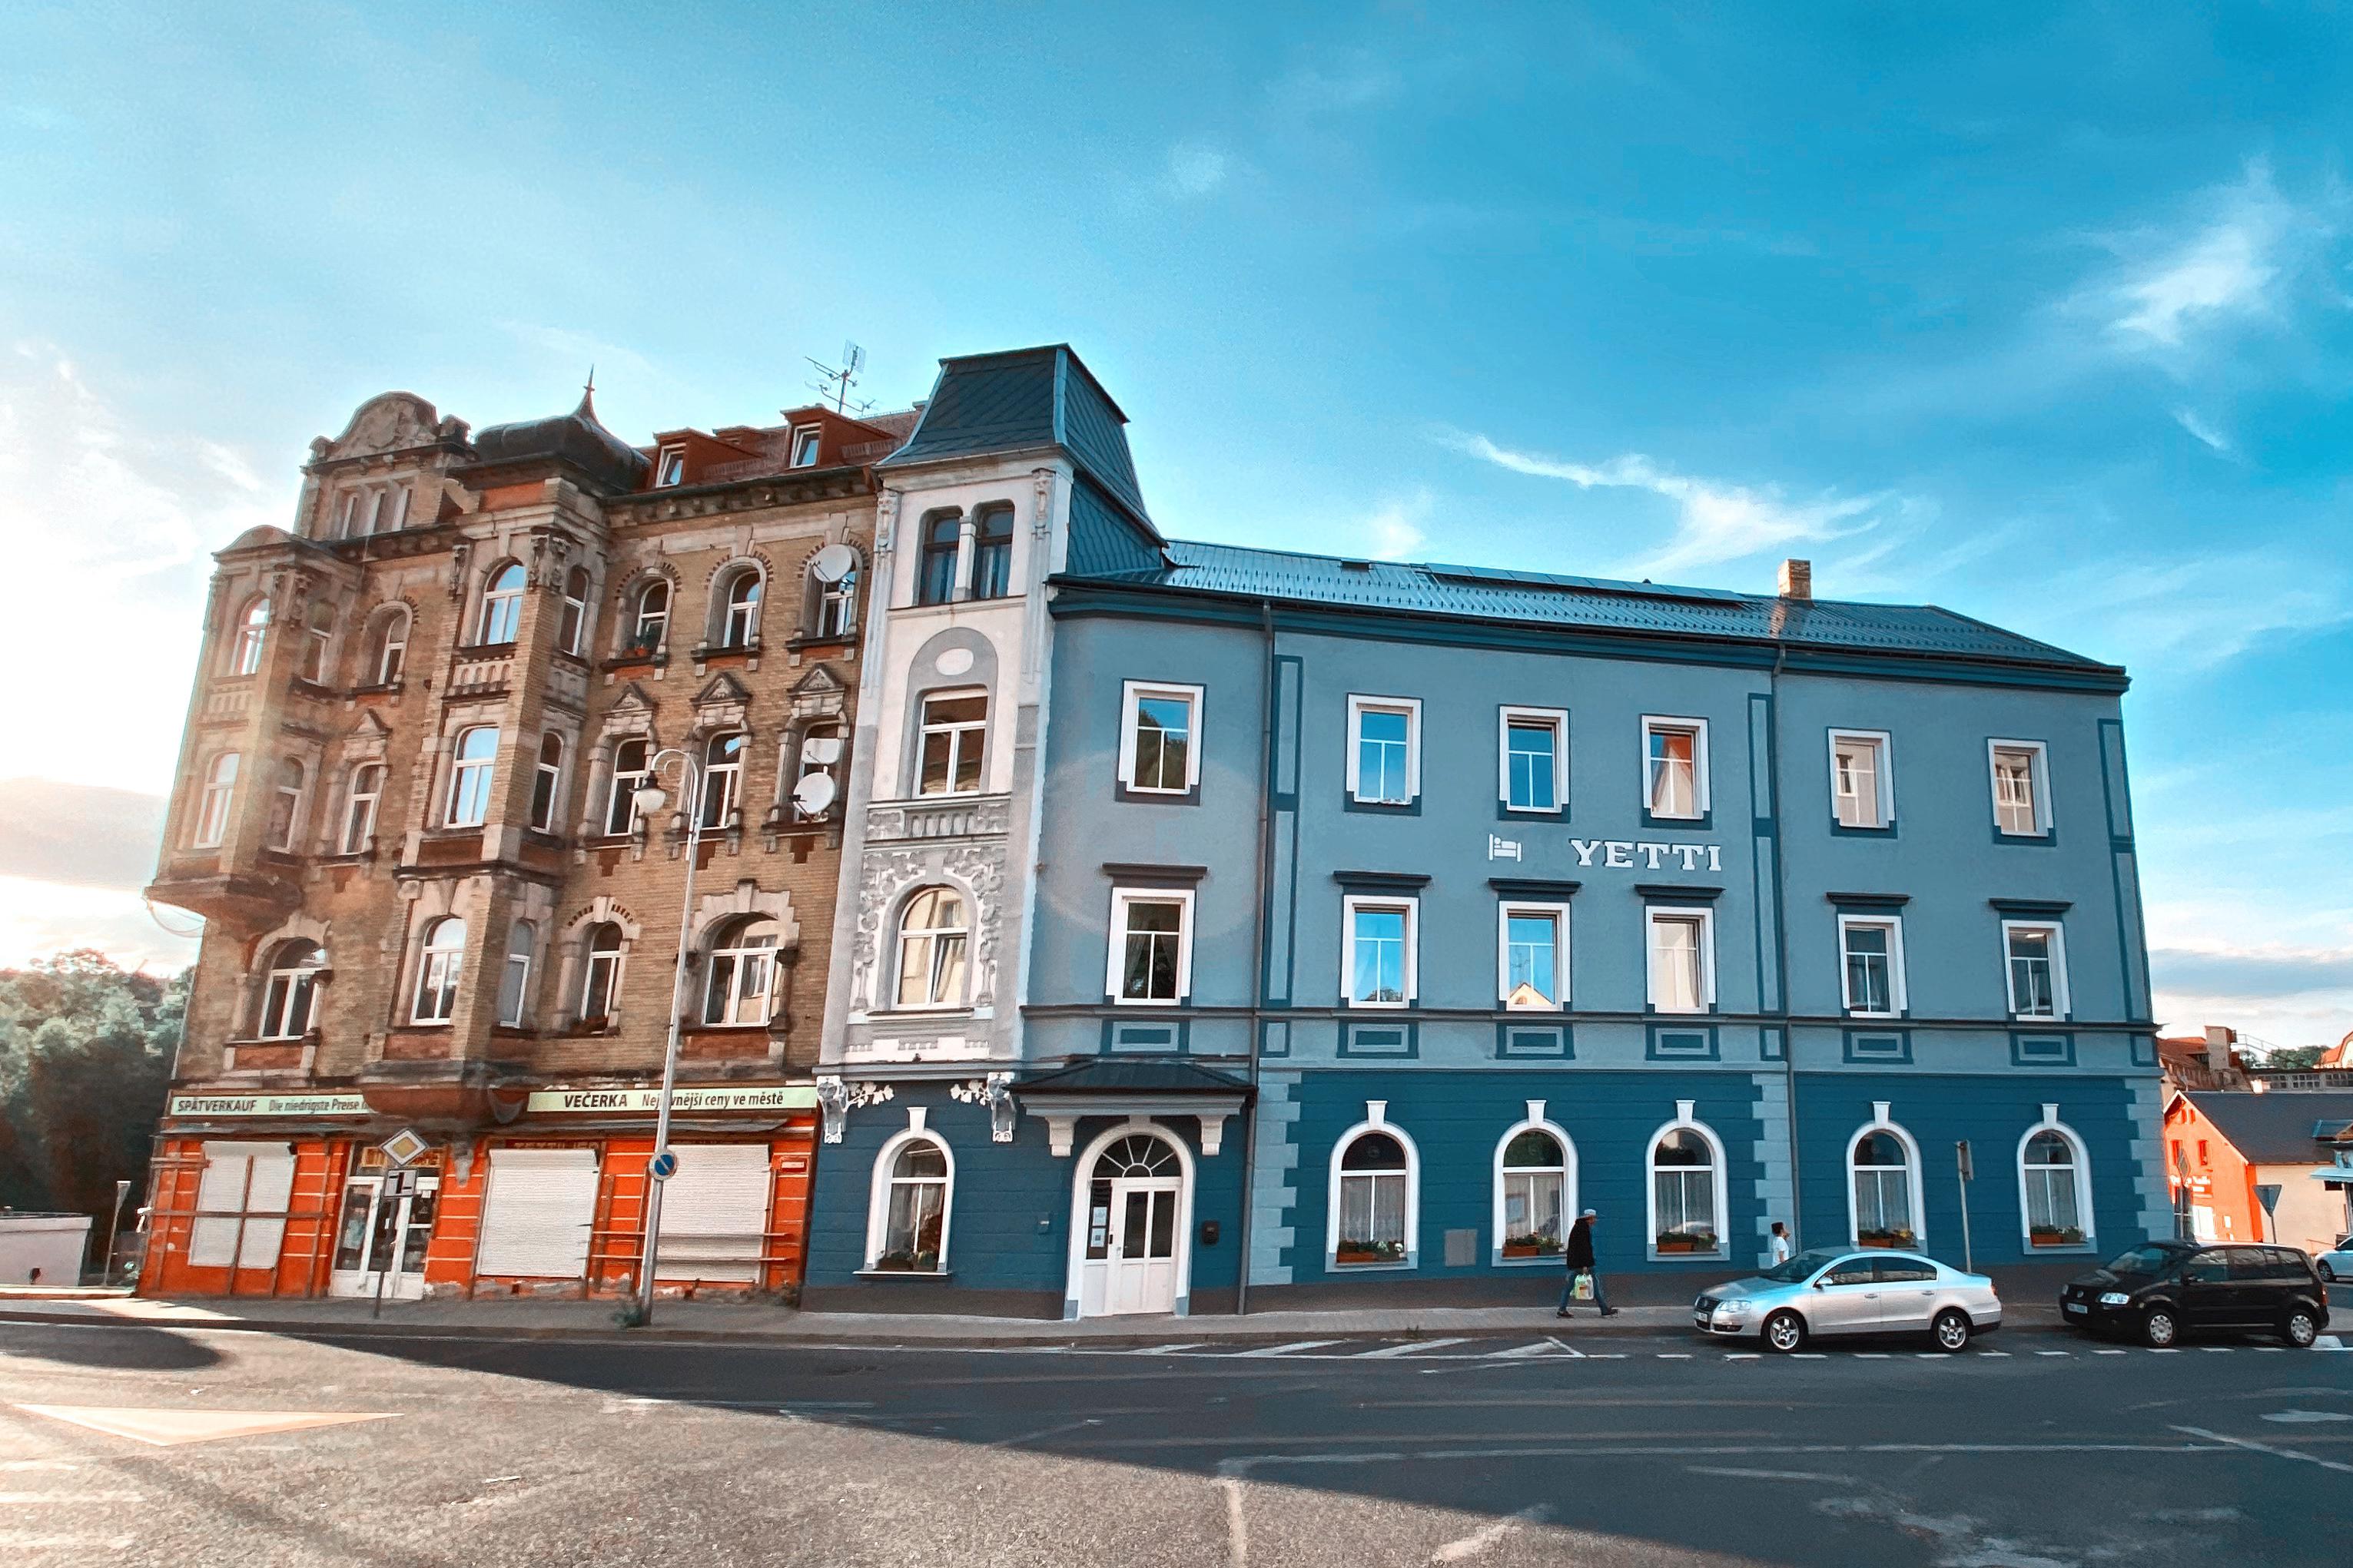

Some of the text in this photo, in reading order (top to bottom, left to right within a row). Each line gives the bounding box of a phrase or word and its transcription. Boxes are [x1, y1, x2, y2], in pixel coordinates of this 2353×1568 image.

[1570, 838, 1722, 871] YETTI
[178, 1096, 257, 1112] SPÄTVERKAUF
[332, 1098, 359, 1111] Preise
[565, 1090, 783, 1110] VEČERKA Nejvnější ceny ve městě
